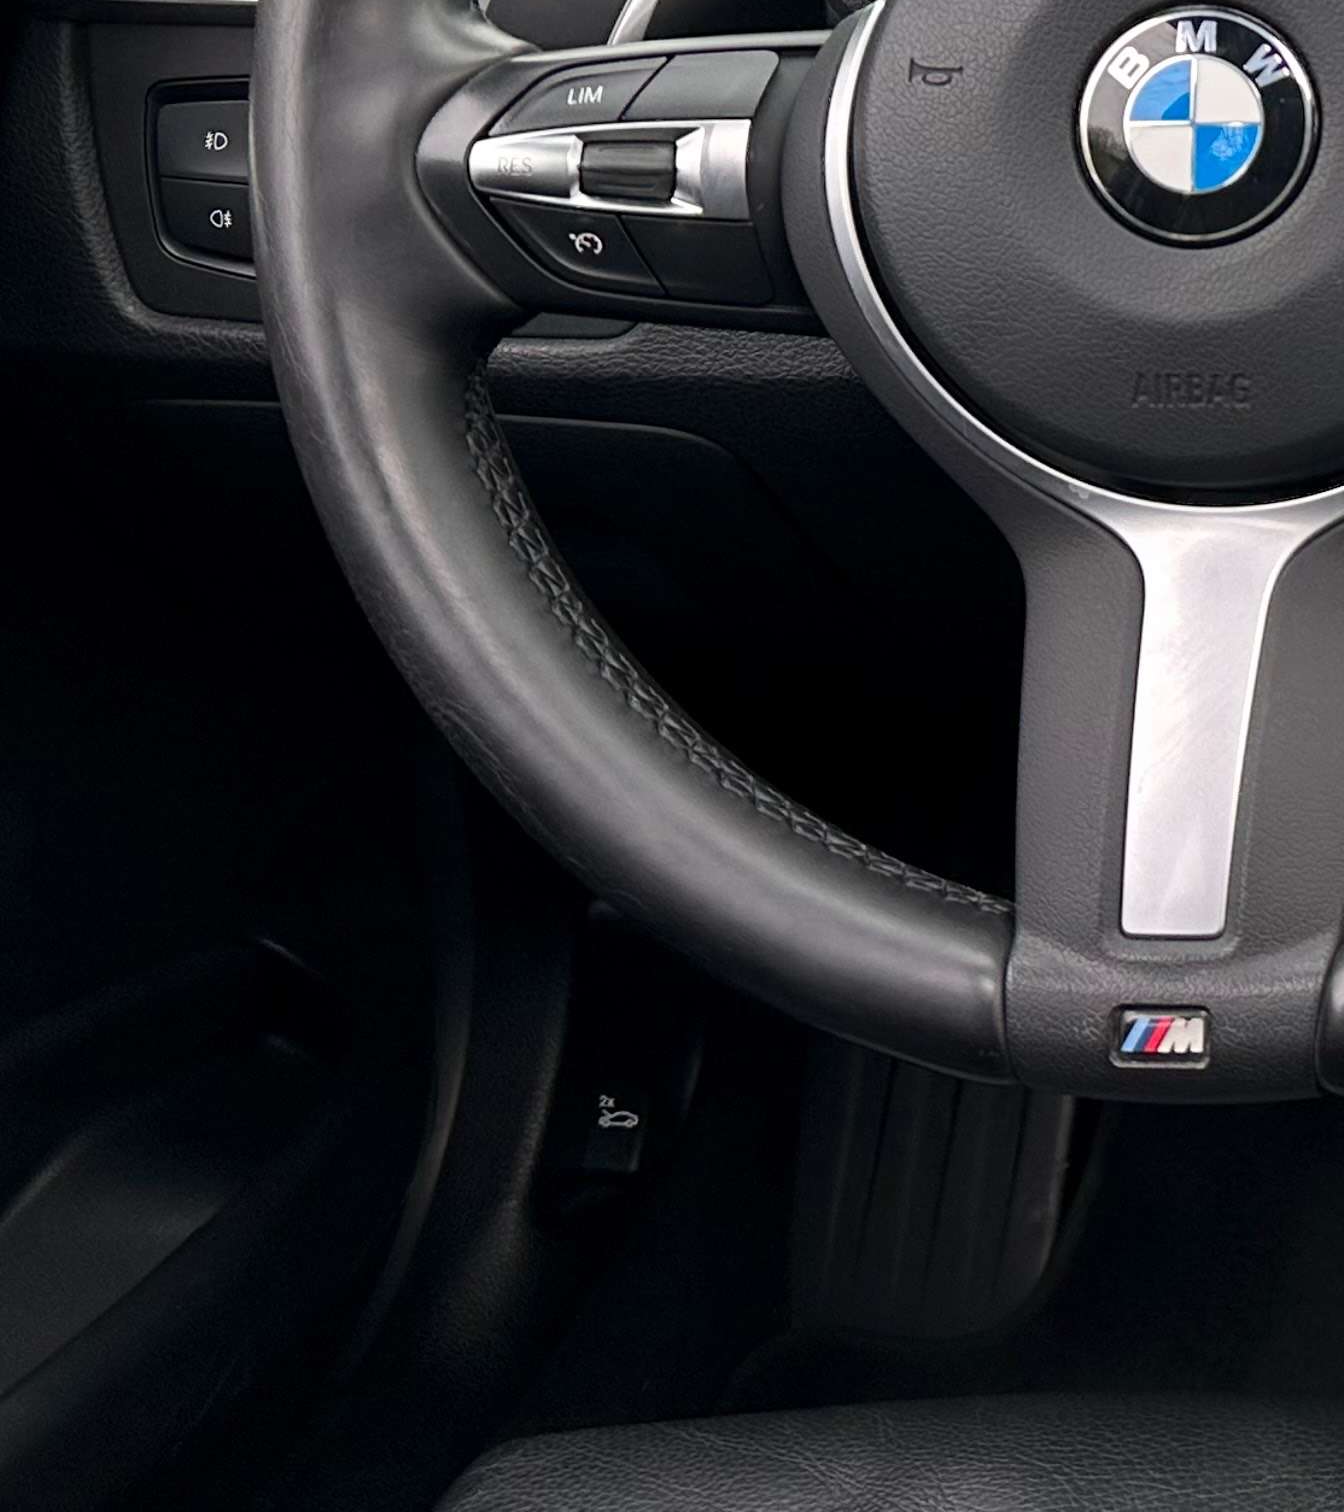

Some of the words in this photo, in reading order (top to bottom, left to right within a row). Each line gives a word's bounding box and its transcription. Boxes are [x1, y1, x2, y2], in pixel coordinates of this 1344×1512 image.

[1107, 18, 1291, 91] BMW
[566, 85, 603, 107] LIM
[1130, 372, 1254, 410] AIRBAG
